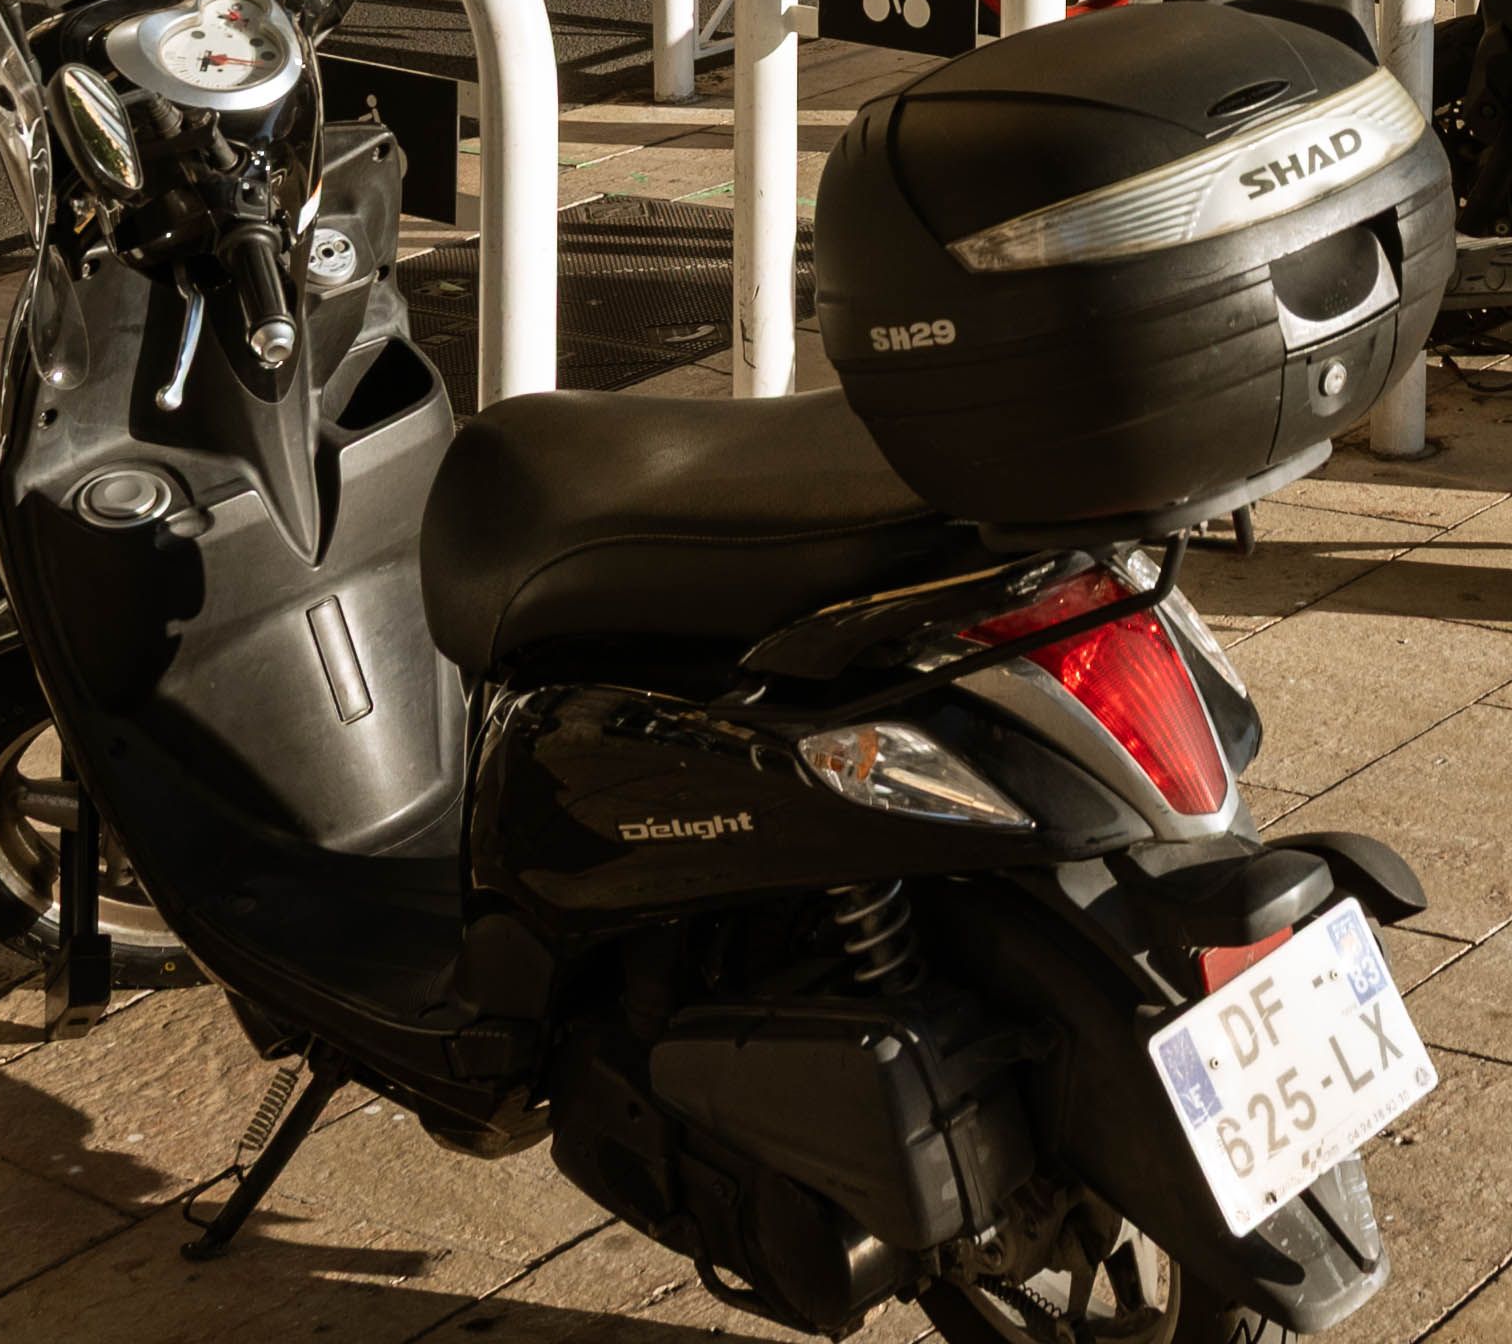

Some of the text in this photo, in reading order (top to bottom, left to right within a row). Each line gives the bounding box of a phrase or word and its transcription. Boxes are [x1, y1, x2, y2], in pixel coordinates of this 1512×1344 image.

[1238, 127, 1363, 201] SHAD
[870, 318, 957, 353] SH29
[1352, 956, 1382, 995] 83
[1215, 1000, 1405, 1179] 625-LX
